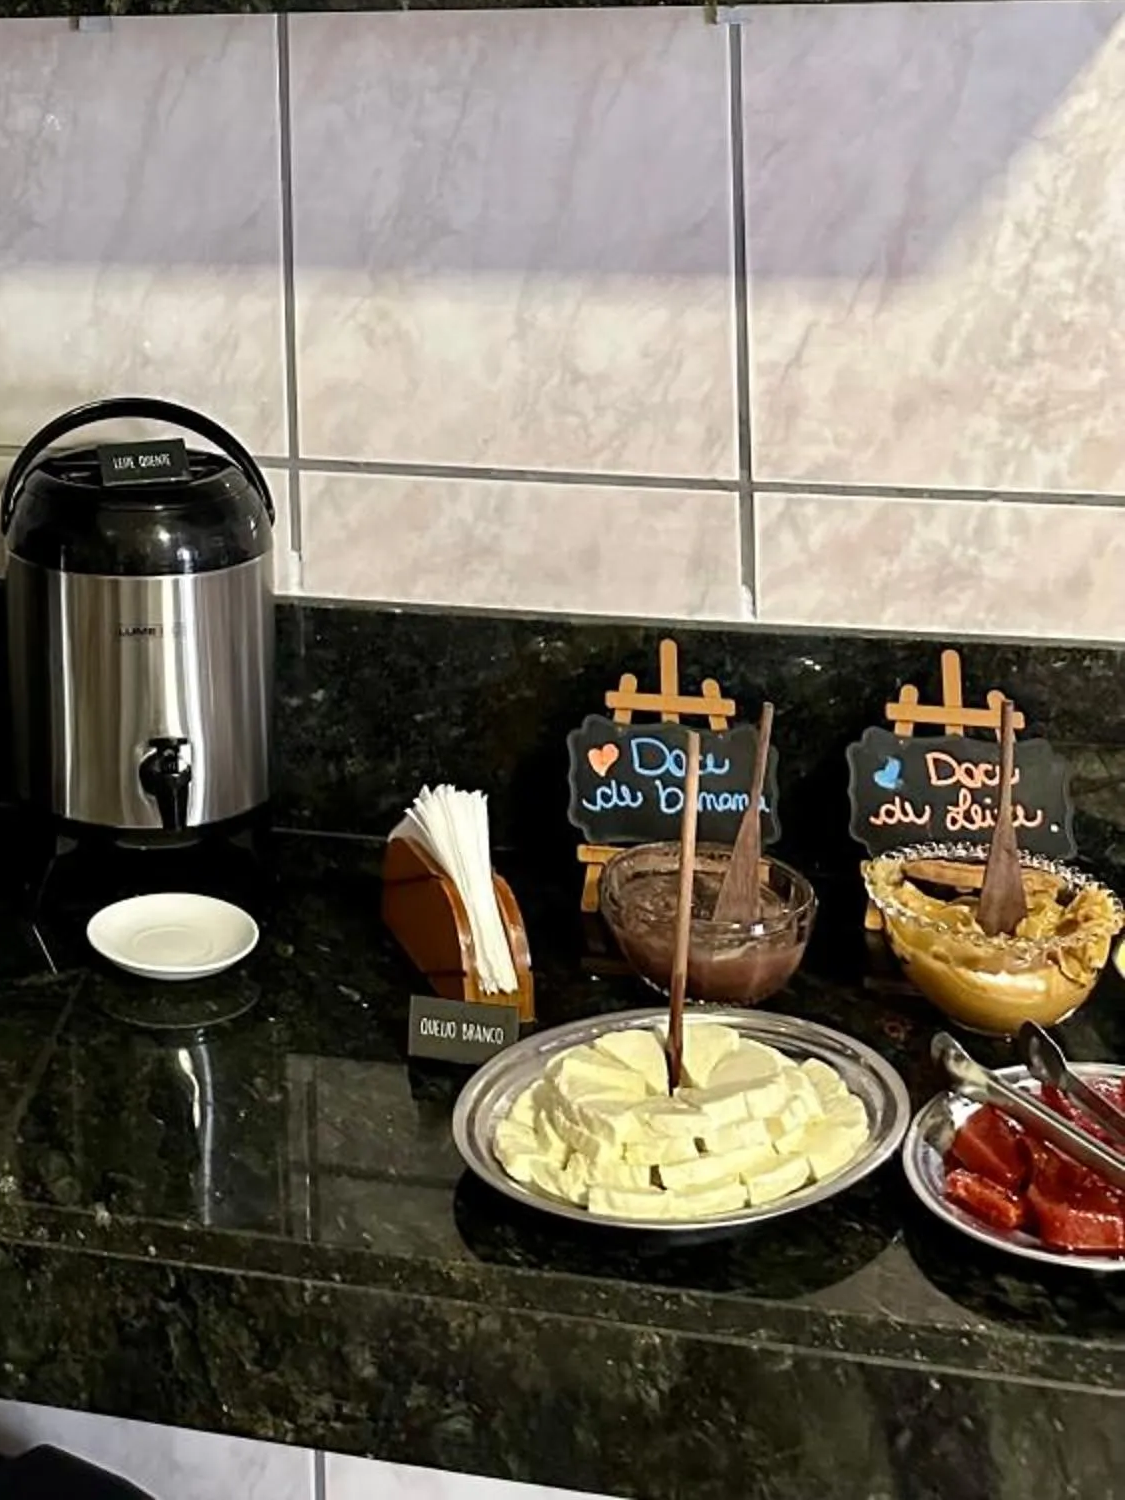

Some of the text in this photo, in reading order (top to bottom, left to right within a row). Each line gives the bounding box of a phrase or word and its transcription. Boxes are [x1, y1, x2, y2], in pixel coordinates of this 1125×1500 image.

[631, 737, 731, 777] Doe
[582, 779, 771, 814] de bnan
[869, 787, 1044, 831] de Leie
[462, 1023, 505, 1045] BRANCO
